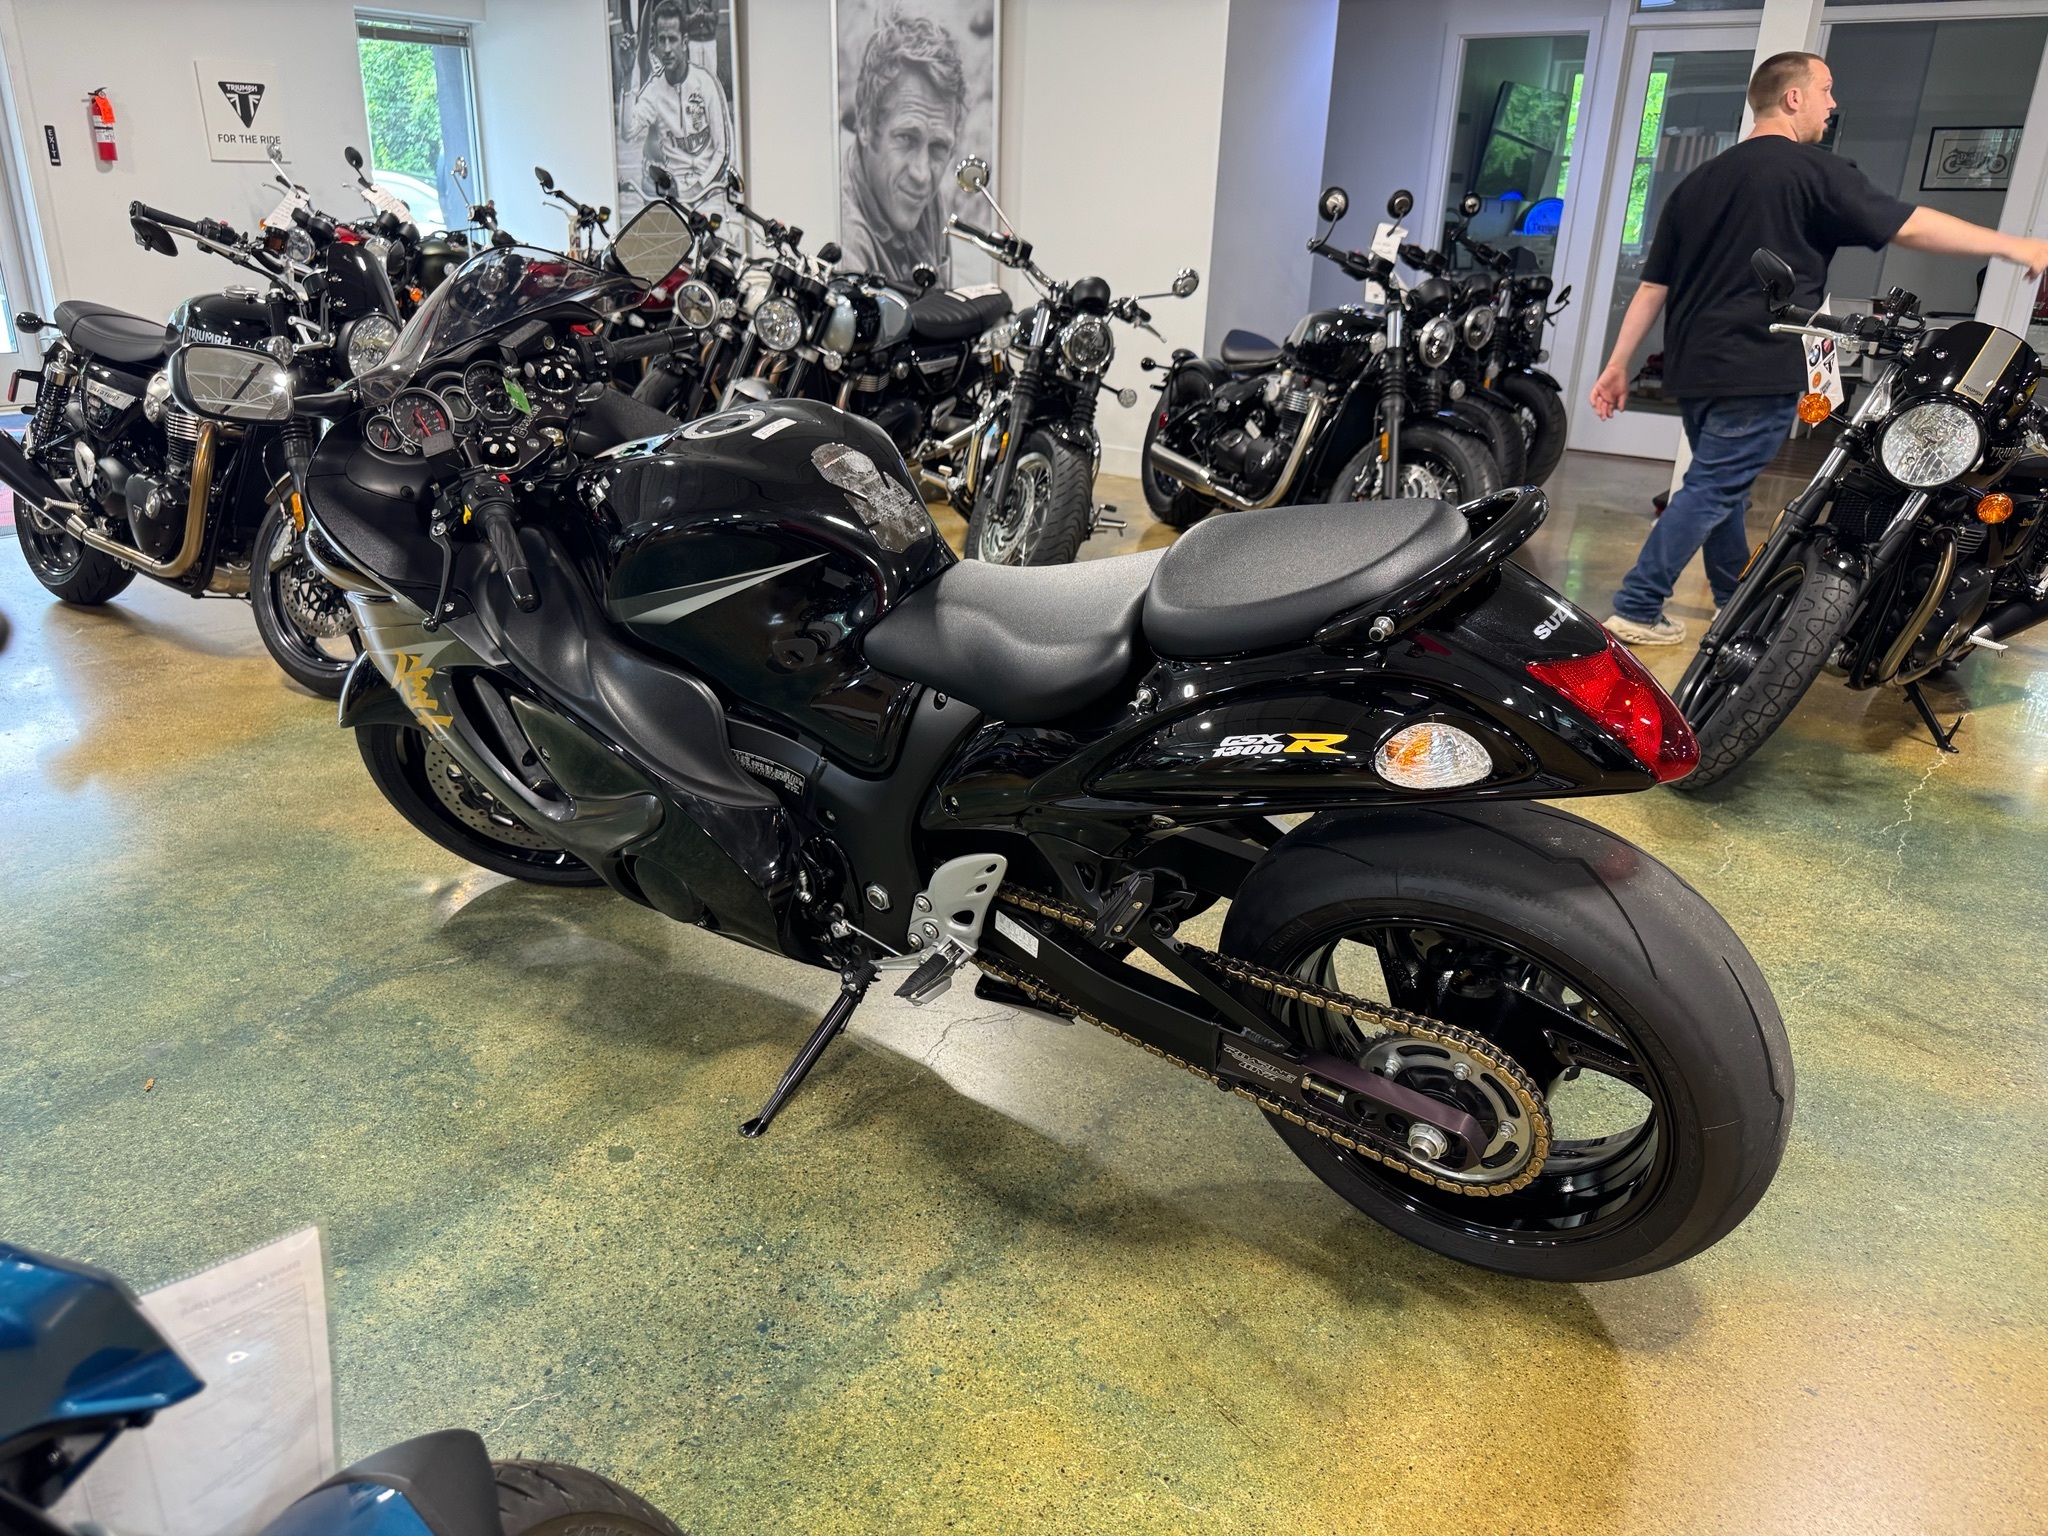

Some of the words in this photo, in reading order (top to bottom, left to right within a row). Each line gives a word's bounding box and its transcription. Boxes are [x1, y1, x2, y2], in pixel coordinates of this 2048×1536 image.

[225, 83, 258, 94] TRIUMPH
[47, 129, 57, 157] EXIT
[217, 133, 237, 144] FOR
[239, 134, 258, 144] THE
[260, 135, 282, 145] RIDE
[1533, 597, 1573, 640] SUZ
[1220, 733, 1286, 747] GSX
[1212, 744, 1285, 758] 1300
